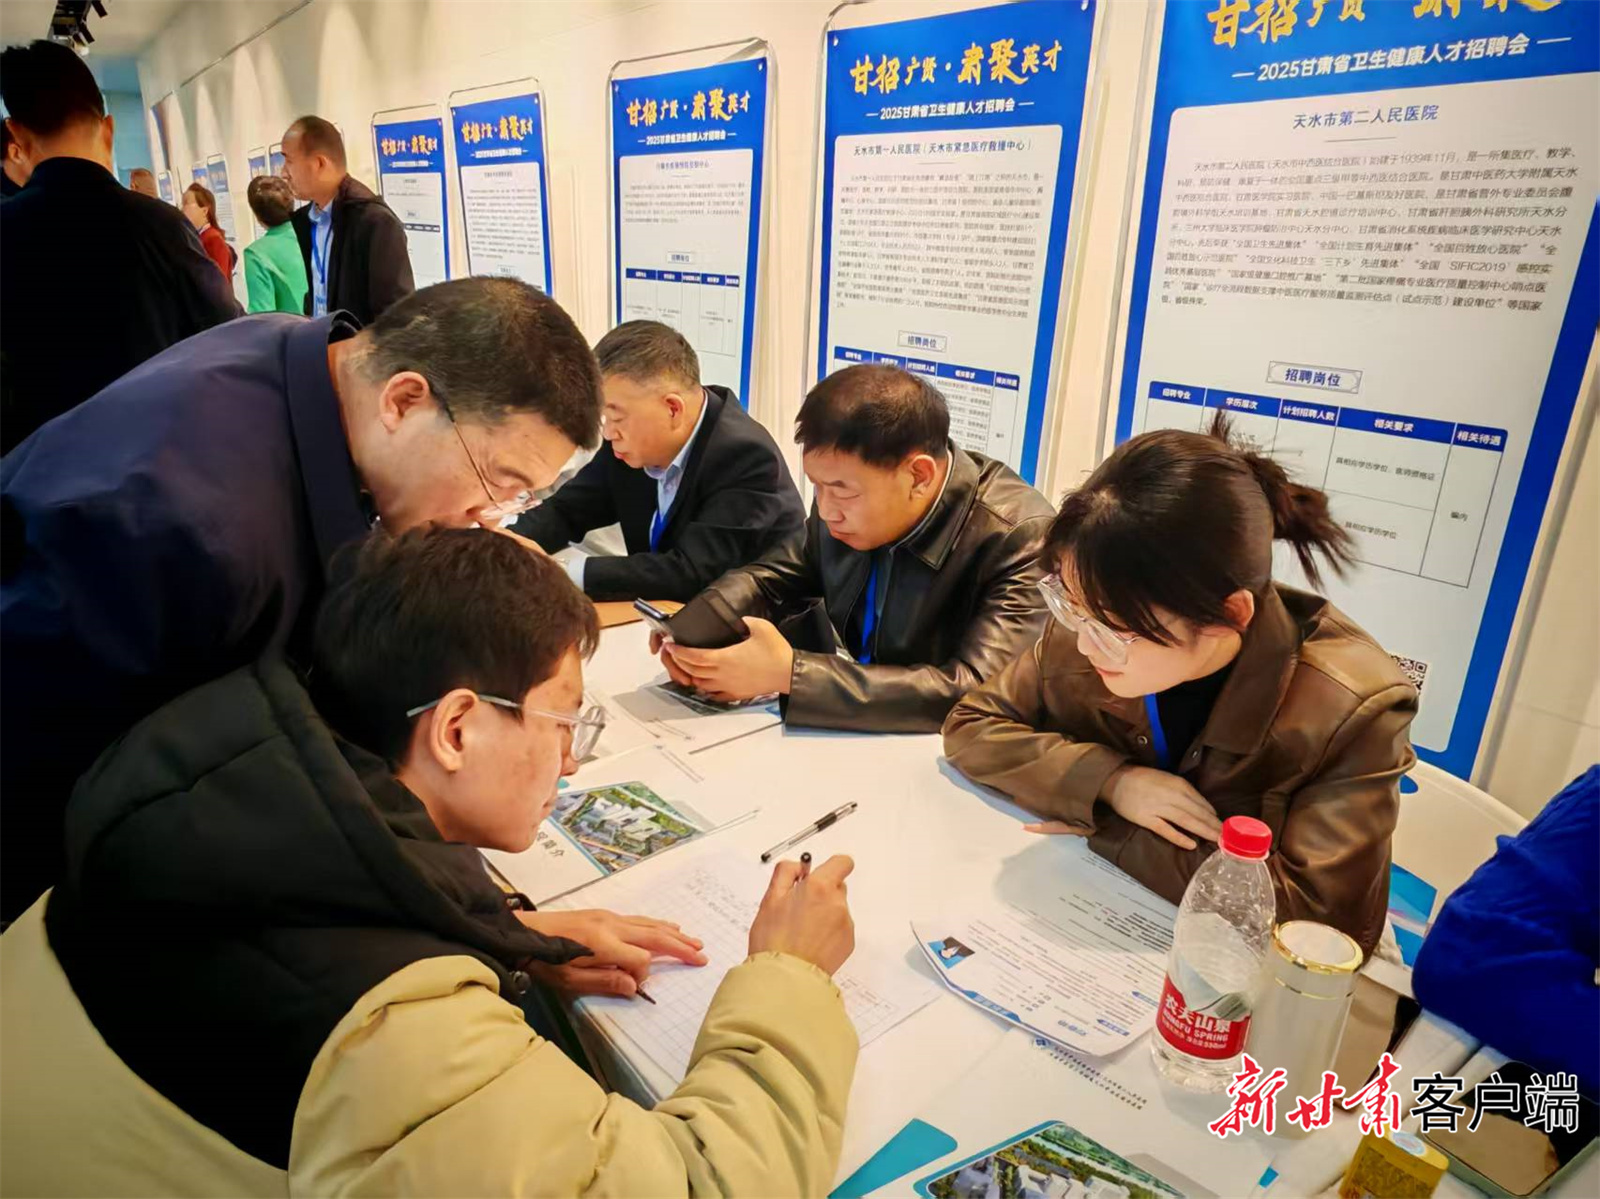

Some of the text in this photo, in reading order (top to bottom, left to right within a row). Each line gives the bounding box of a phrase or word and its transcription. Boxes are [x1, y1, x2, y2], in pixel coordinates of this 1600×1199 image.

[1258, 34, 1530, 81] 2025甘肃省卫生健康人才招聘会
[1293, 105, 1438, 129] 天水市第二人民医院
[1285, 368, 1342, 387] 招聘岗位
[1283, 405, 1335, 421] 计划招聘人数
[1458, 431, 1501, 446] 相关待遇
